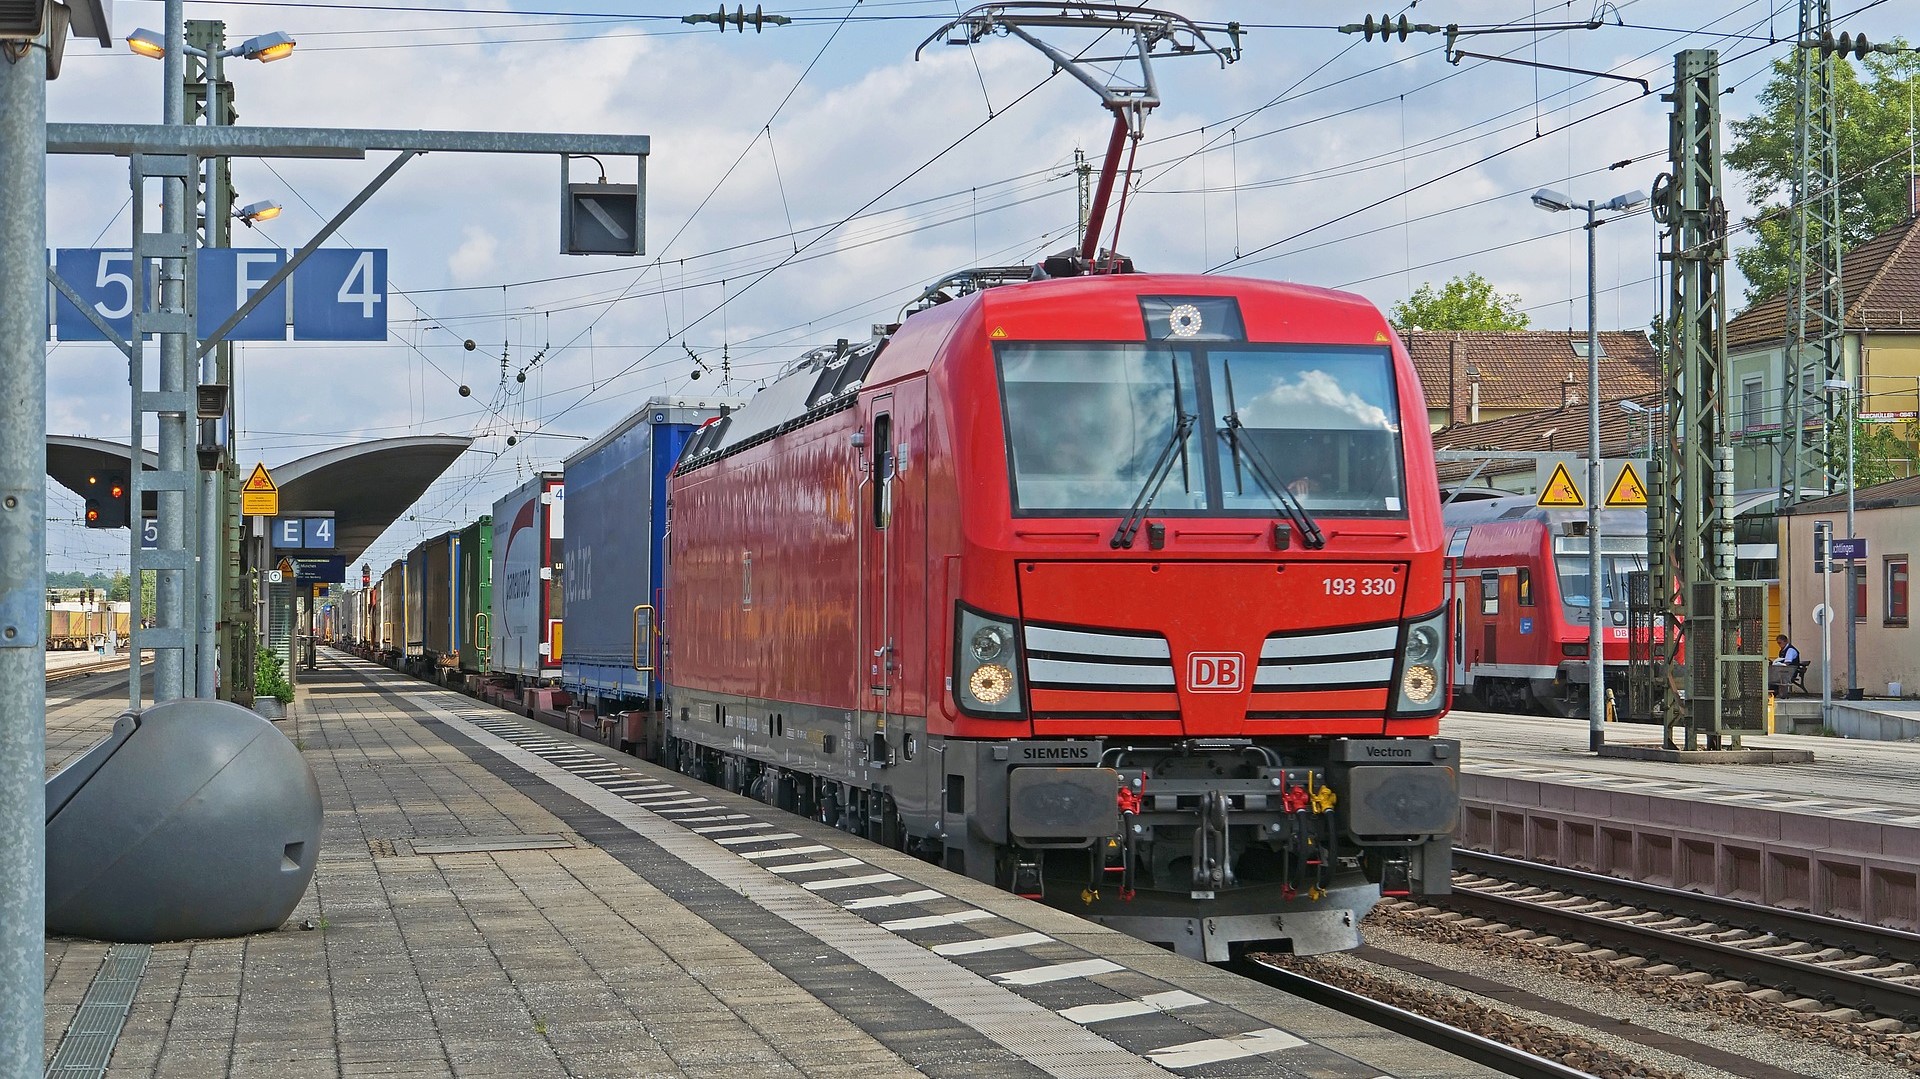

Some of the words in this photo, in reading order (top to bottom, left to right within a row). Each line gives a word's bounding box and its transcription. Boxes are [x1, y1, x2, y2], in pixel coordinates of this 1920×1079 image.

[94, 252, 133, 319] 5
[337, 251, 382, 318] 4
[144, 519, 158, 541] 5
[283, 520, 298, 541] E
[316, 520, 331, 541] 4
[1322, 578, 1355, 595] 193
[1361, 578, 1396, 595] 330
[1615, 629, 1627, 637] DB
[1195, 659, 1237, 685] DB
[1023, 747, 1088, 759] SIEMENS
[1366, 745, 1412, 758] Vectron
